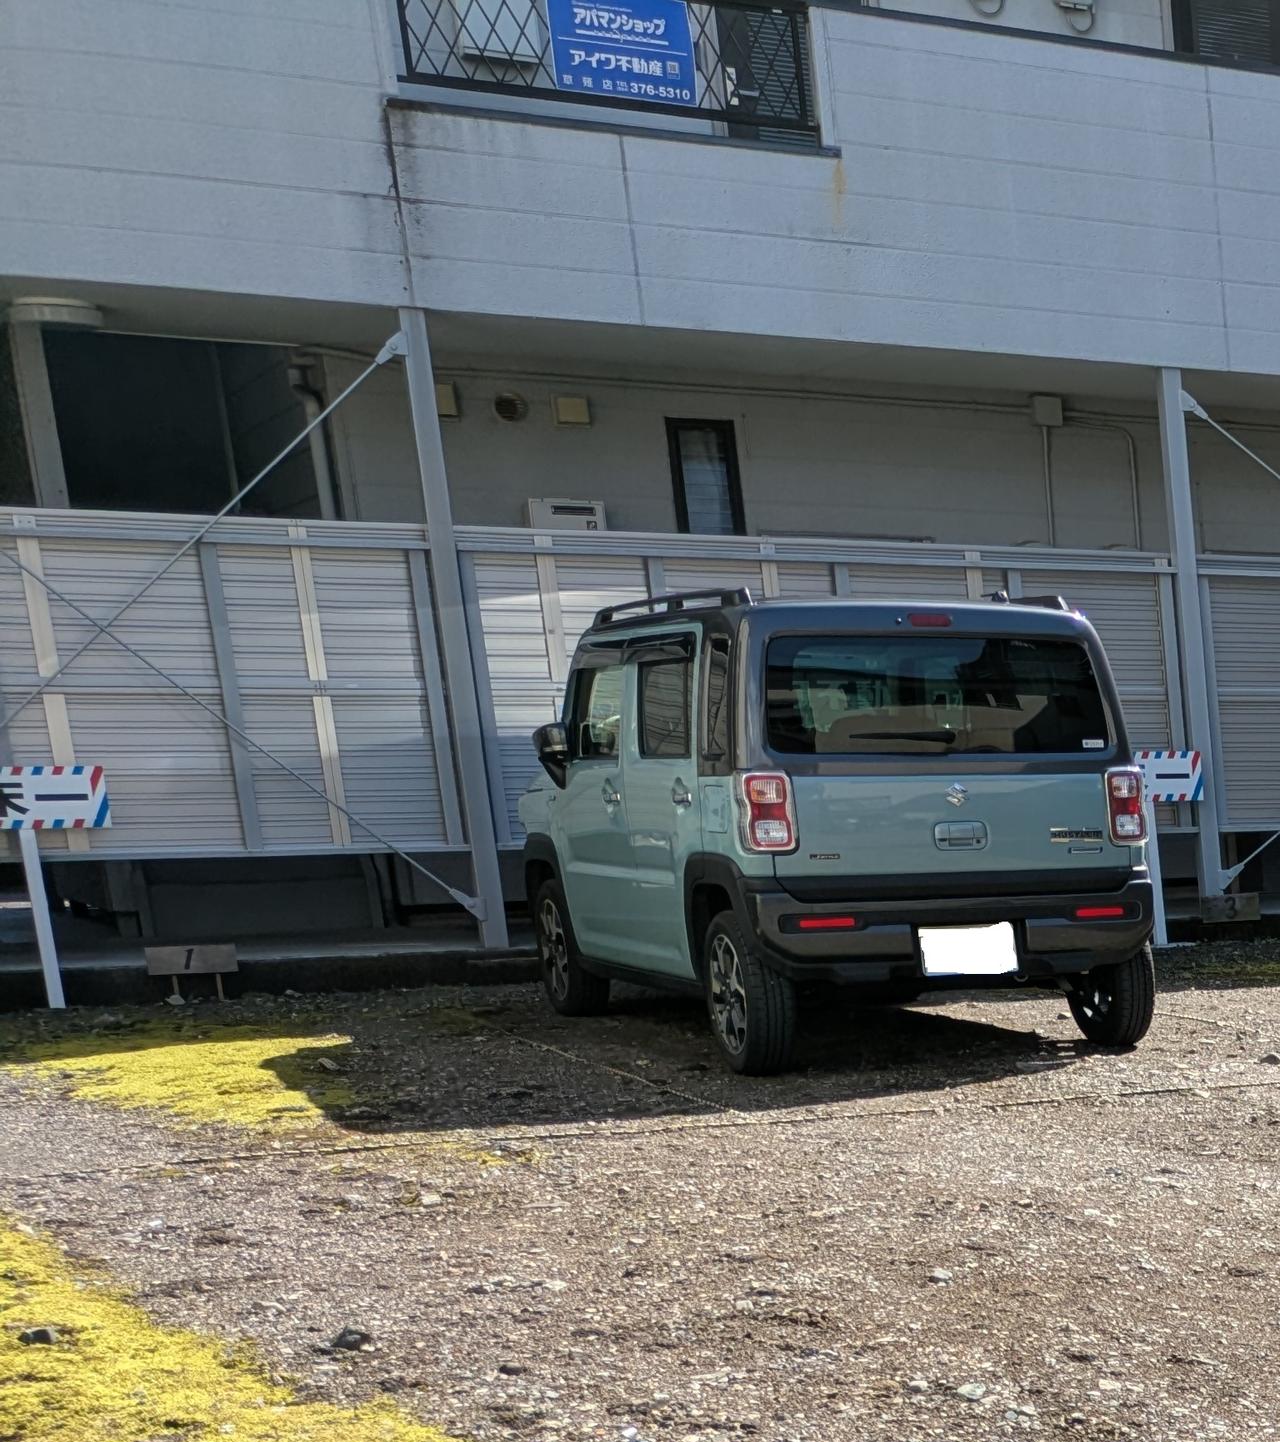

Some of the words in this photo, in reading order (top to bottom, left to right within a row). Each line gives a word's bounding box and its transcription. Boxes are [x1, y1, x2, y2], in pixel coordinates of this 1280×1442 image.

[573, 7, 666, 35] アパマンショップ
[569, 49, 664, 76] アイワ不動産
[630, 82, 690, 100] 376-5310
[1224, 896, 1237, 919] 3
[184, 948, 194, 970] 1
